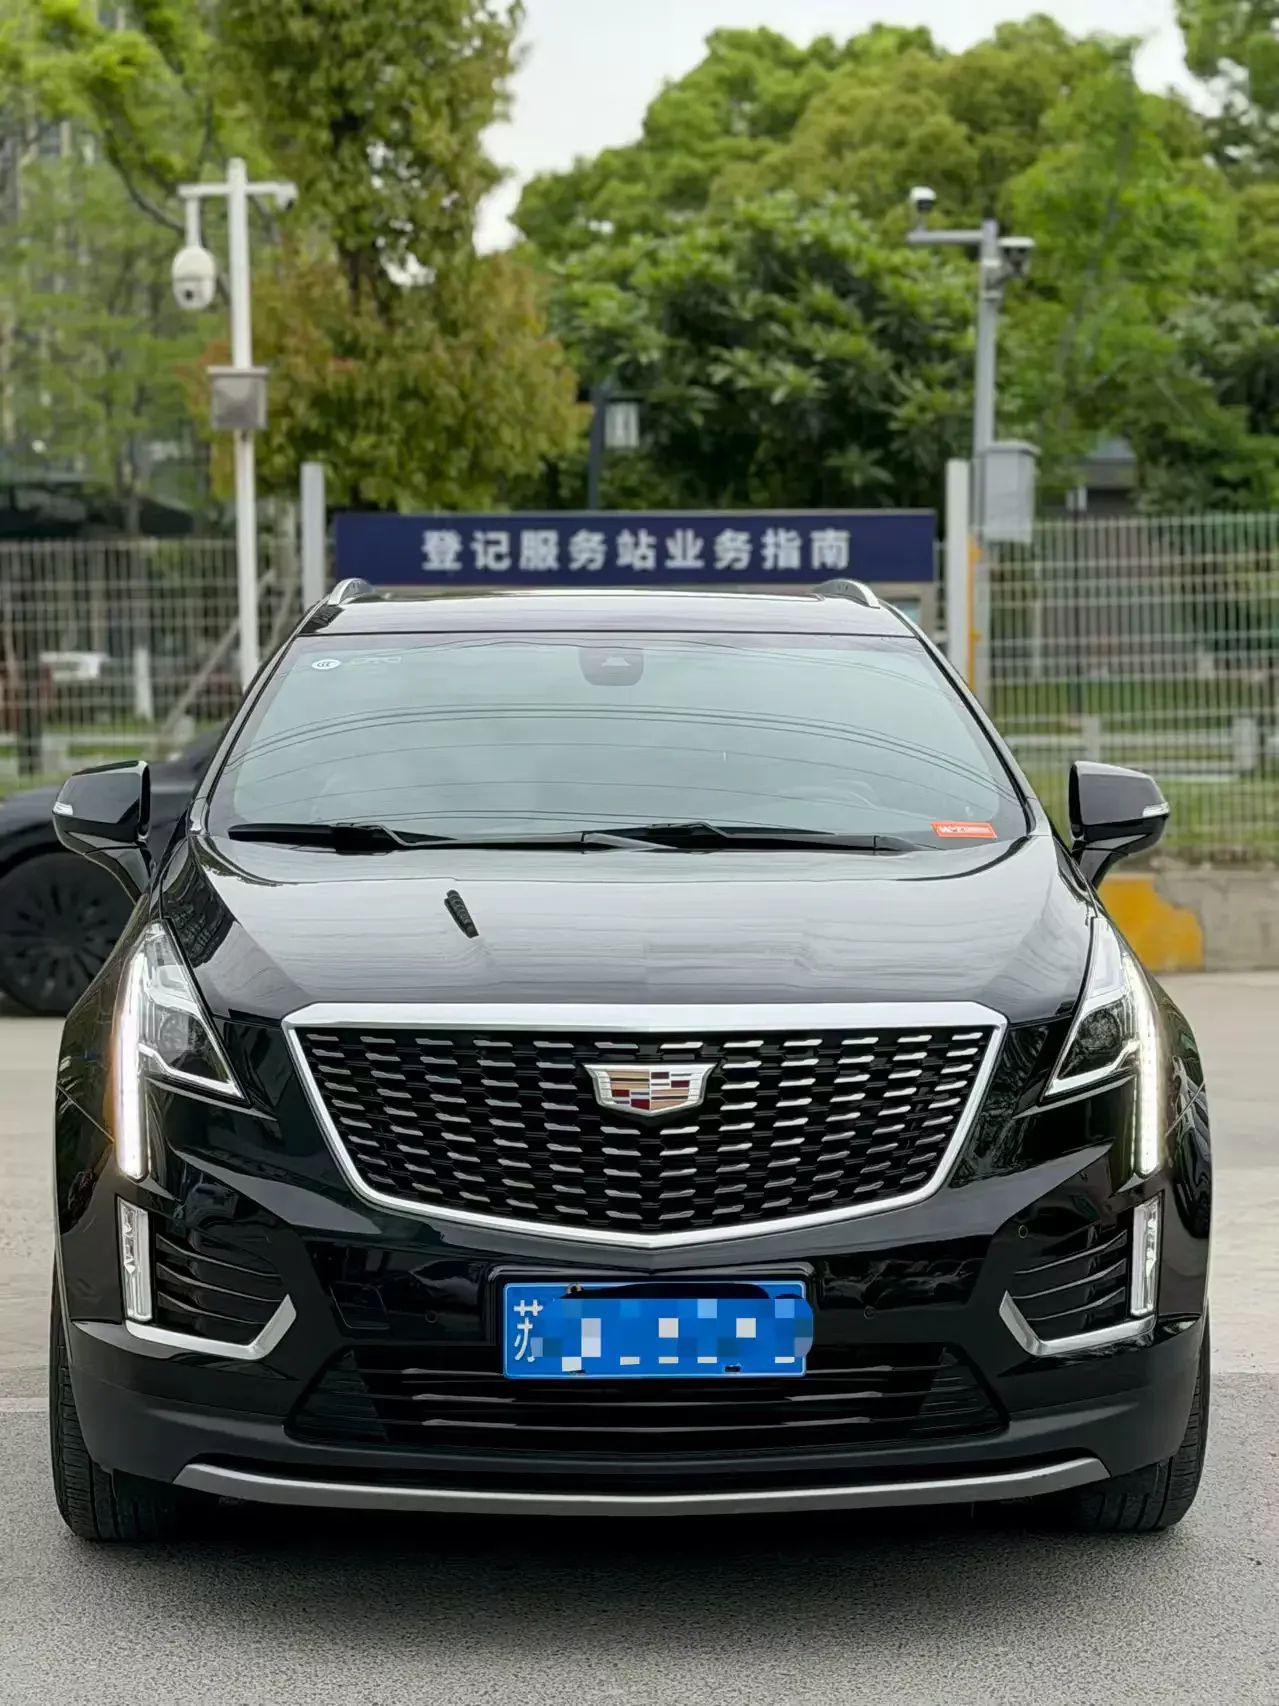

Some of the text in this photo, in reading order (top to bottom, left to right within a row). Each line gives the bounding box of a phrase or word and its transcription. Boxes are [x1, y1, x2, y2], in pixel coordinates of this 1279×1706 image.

[421, 529, 851, 571] 登记服务站业务指南
